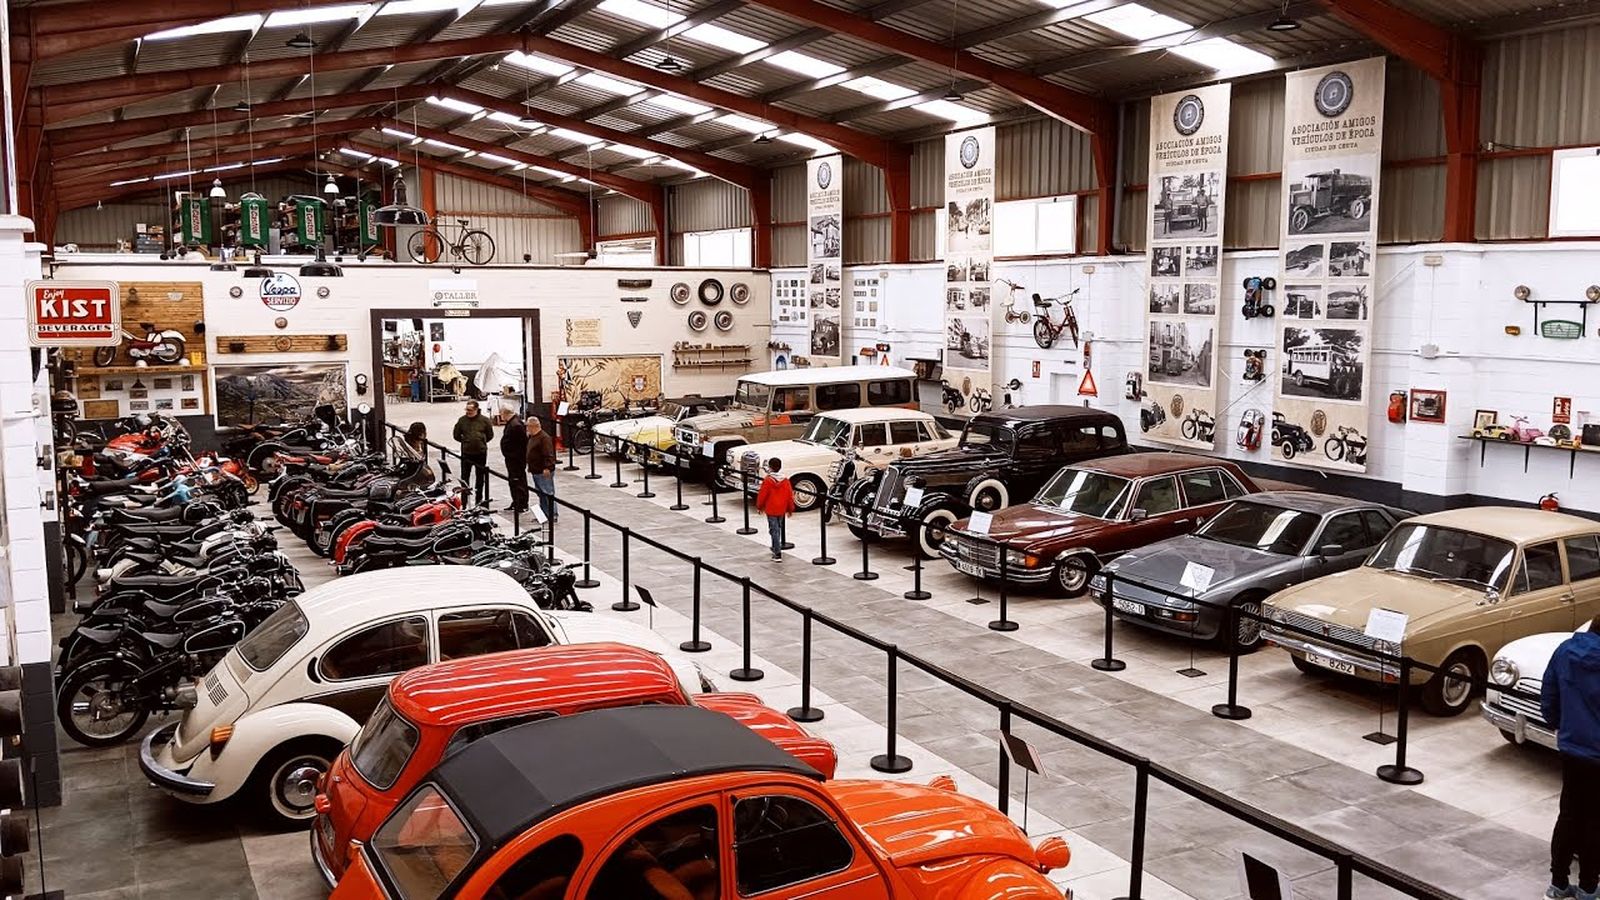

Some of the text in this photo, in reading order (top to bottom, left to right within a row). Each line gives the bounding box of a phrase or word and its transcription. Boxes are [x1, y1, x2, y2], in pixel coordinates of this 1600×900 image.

[1291, 116, 1376, 135] ASOCIACIÓN AMIGOS
[1195, 135, 1222, 146] AMIGOS
[1291, 128, 1375, 146] VEHÍCULOS DE ÉPOCA
[1190, 149, 1199, 157] DE
[43, 289, 65, 300] Enjoy
[263, 279, 298, 295] Vespa
[444, 292, 477, 300] TALLER
[40, 299, 107, 319] KIST
[1329, 658, 1353, 673] 8262
